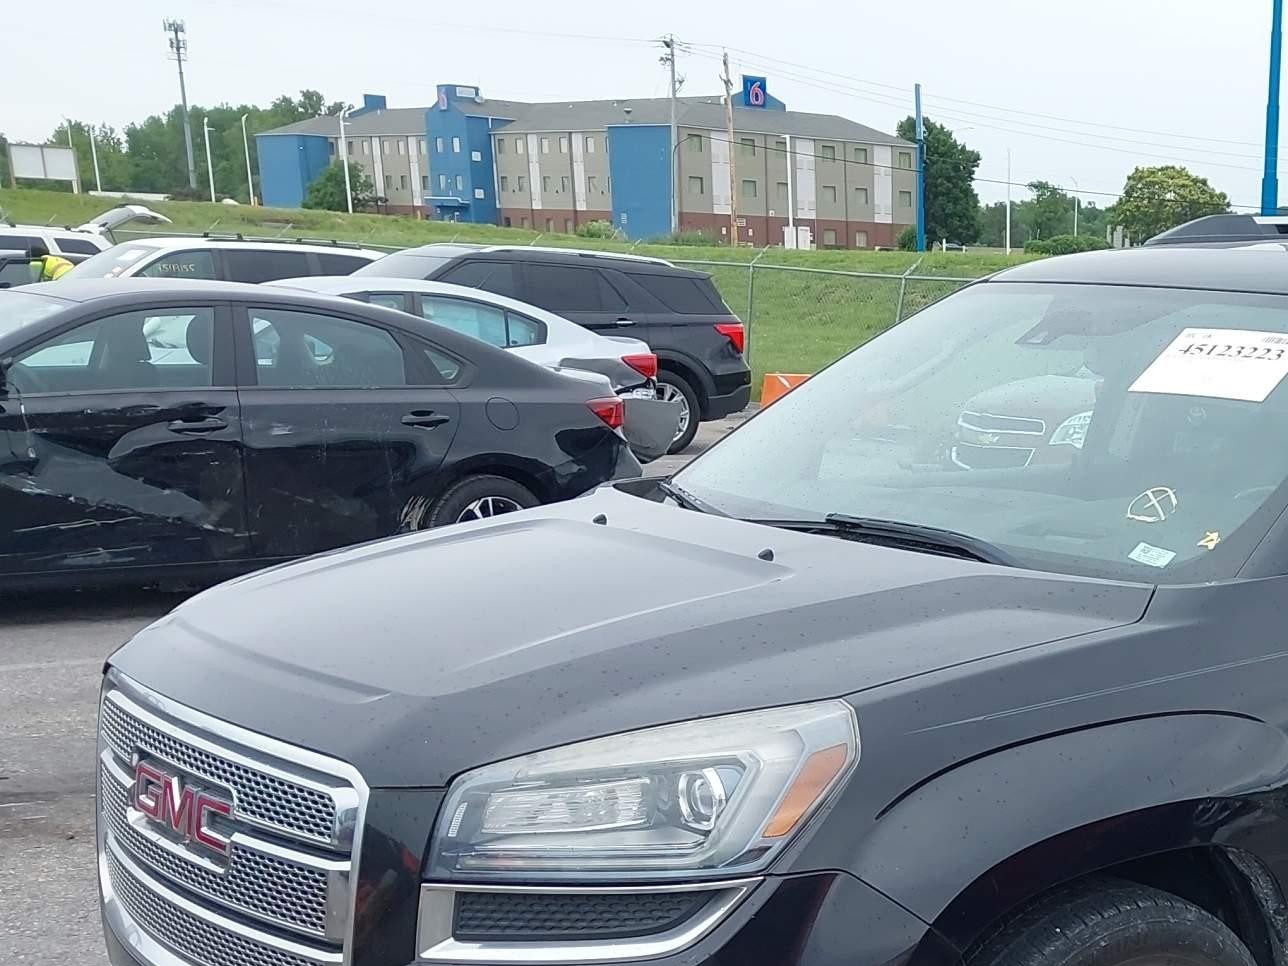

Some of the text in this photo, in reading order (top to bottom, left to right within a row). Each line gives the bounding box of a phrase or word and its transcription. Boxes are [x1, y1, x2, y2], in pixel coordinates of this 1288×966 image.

[750, 81, 764, 105] 6
[1178, 342, 1286, 361] 45123223
[134, 760, 235, 857] GMC
